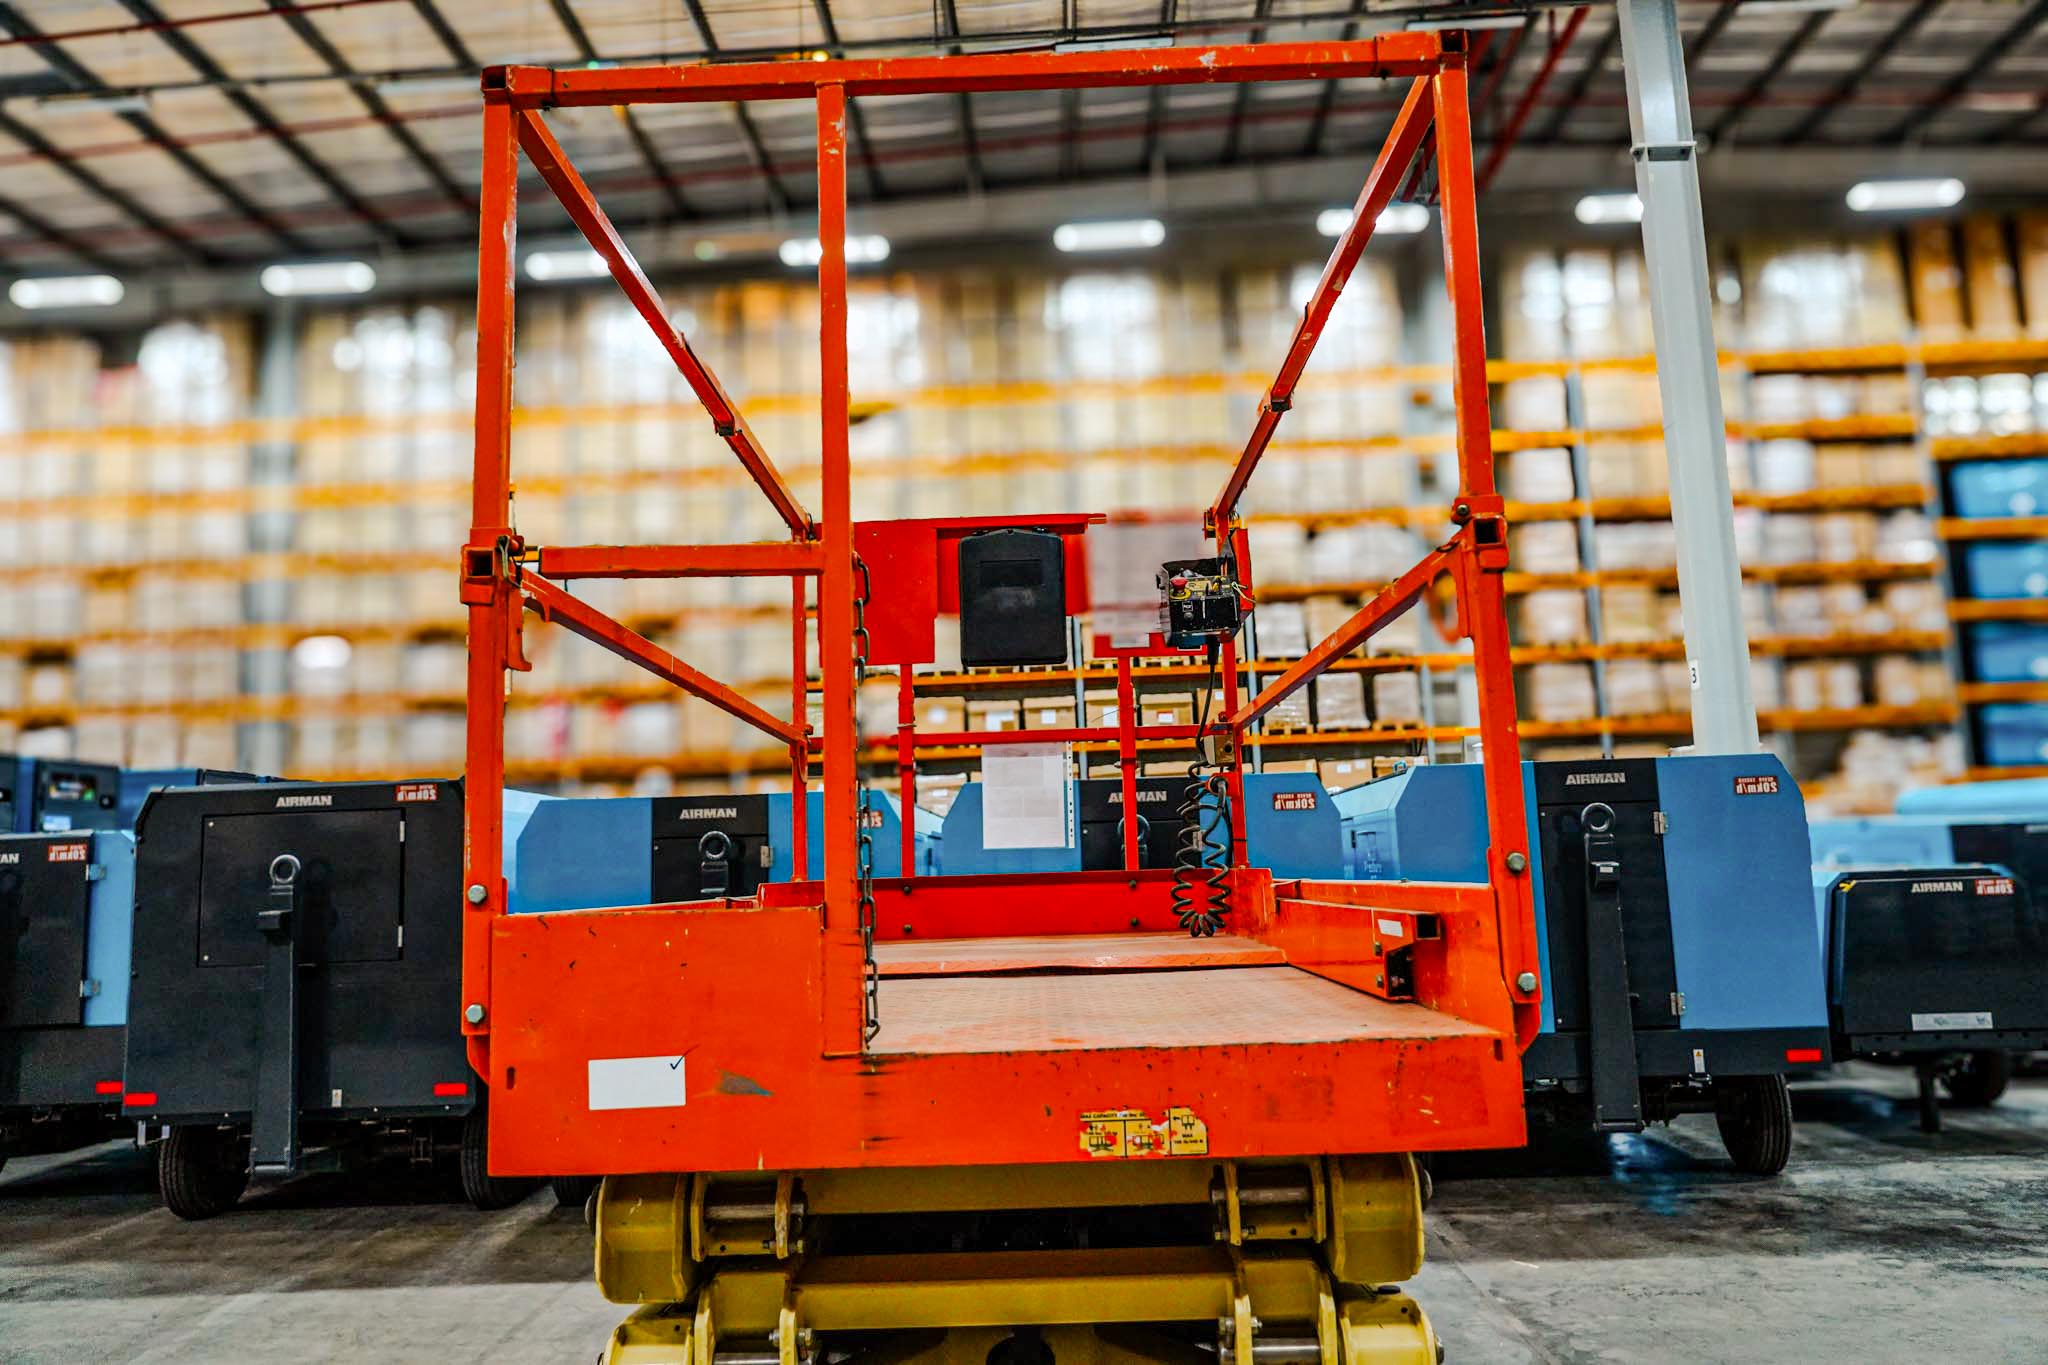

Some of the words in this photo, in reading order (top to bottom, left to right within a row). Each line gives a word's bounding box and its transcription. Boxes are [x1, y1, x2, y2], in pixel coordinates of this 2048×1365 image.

[1566, 772, 1626, 785] AIRMAN
[275, 795, 332, 808] AIRMAN
[1108, 790, 1167, 803] AIMAN
[679, 807, 737, 820] AIRMAN
[0, 853, 20, 864] AN
[1911, 881, 1964, 893] AIRMAN
